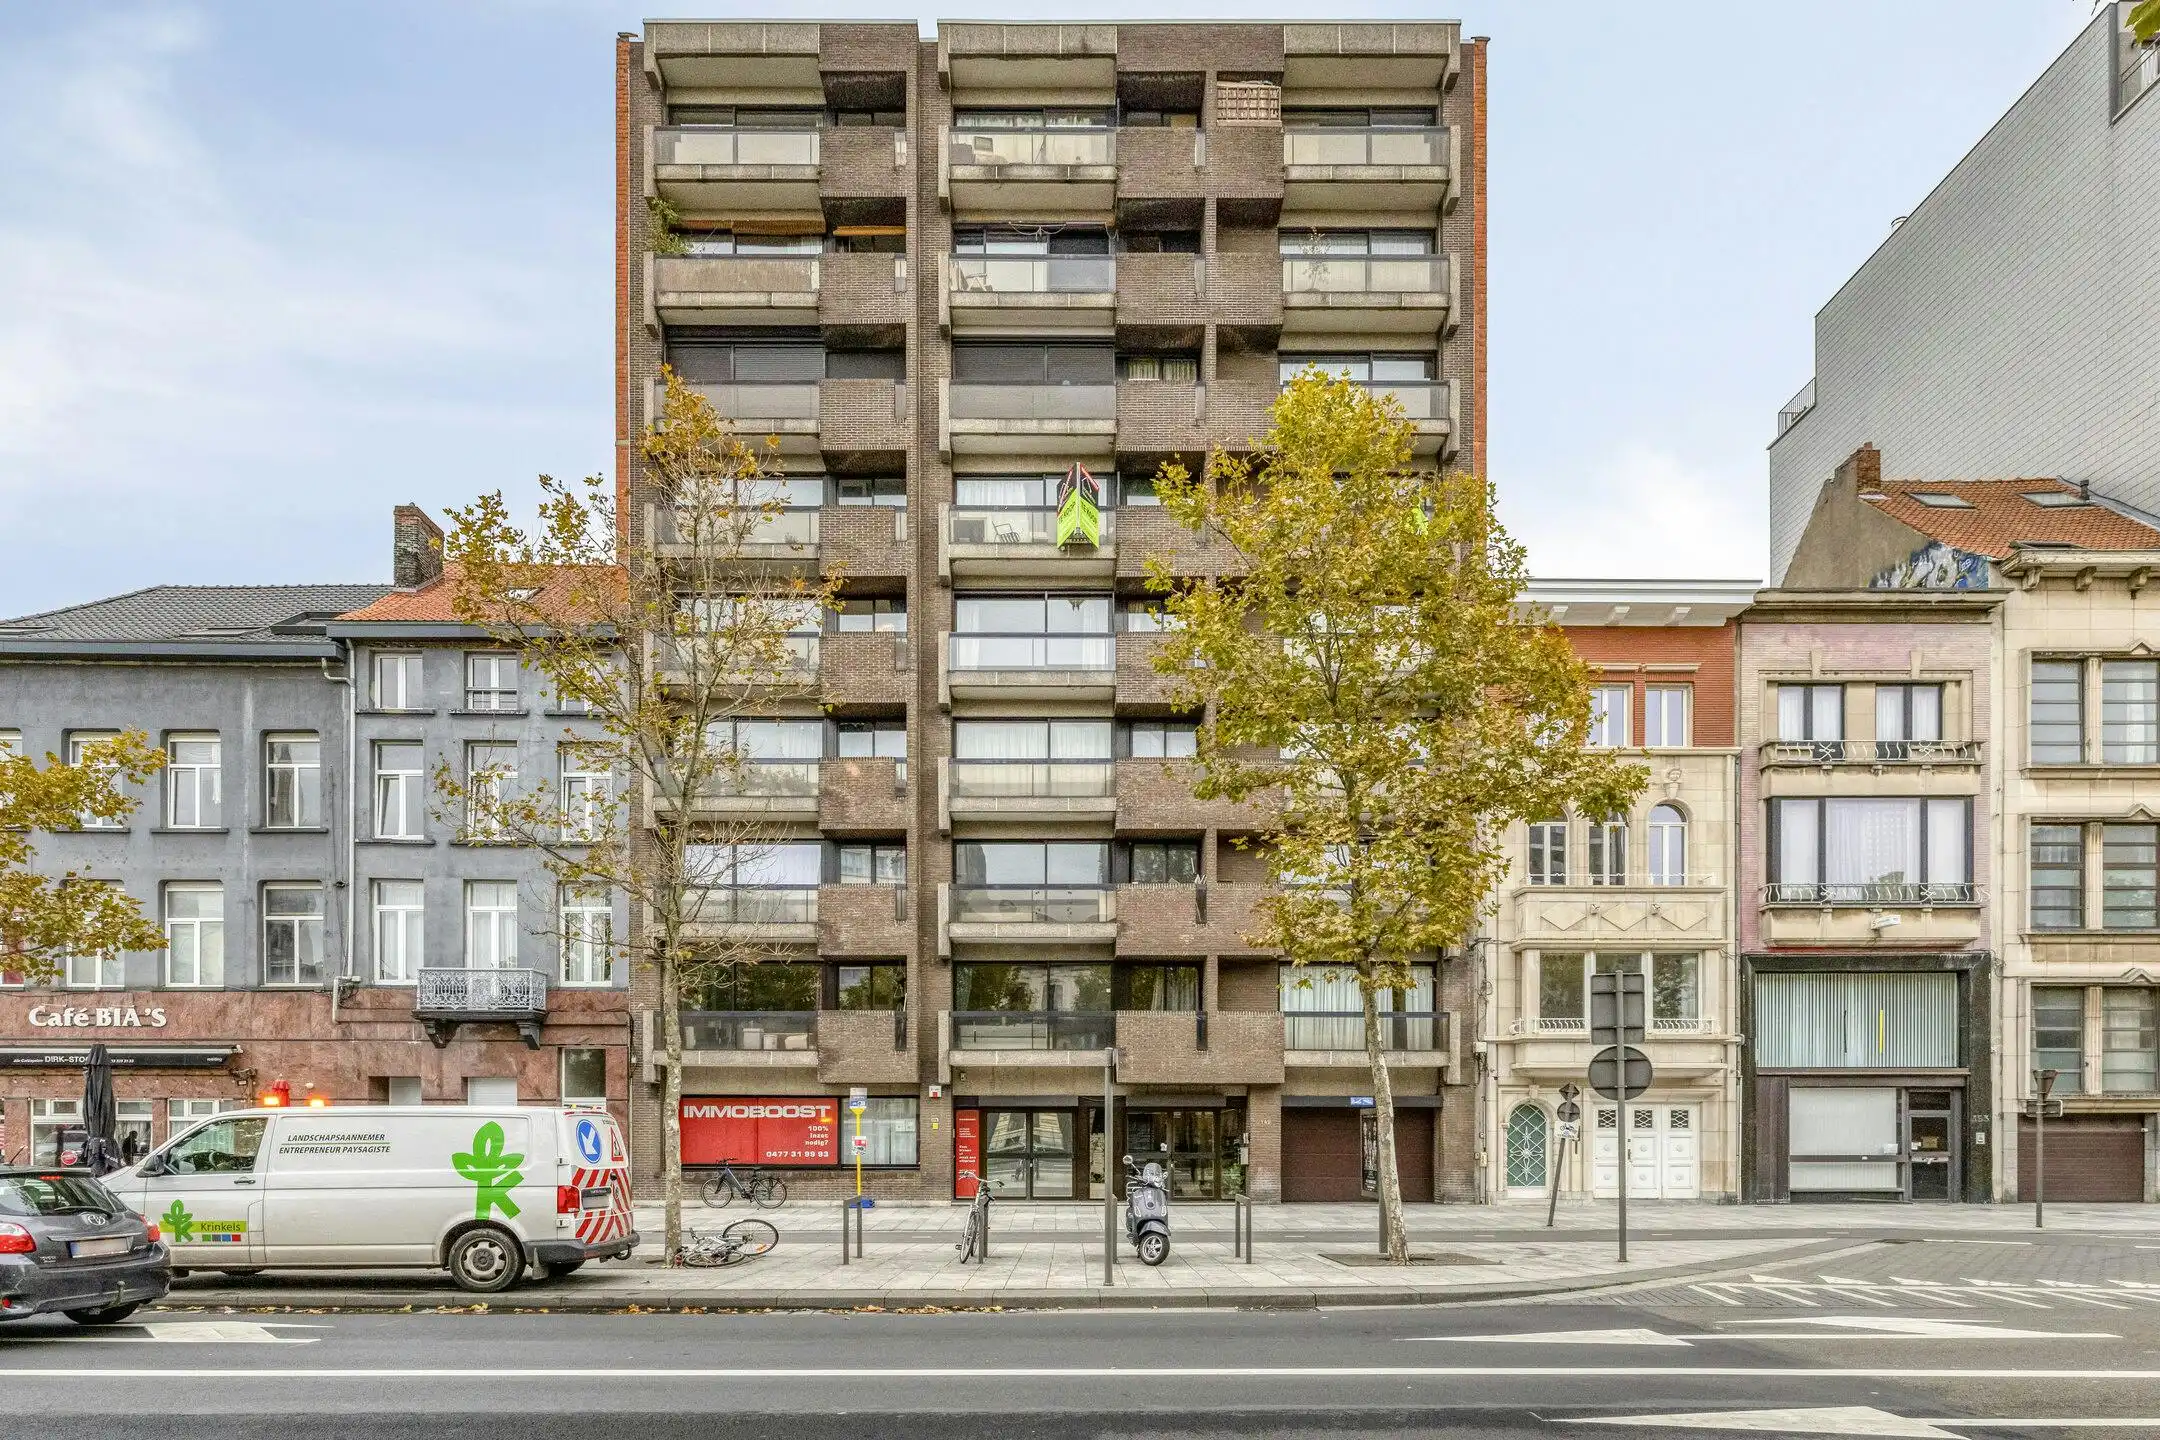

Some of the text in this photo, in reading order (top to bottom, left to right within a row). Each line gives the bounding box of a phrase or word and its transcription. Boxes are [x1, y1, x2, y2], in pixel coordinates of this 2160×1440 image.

[28, 1006, 167, 1027] Café BIA'S
[683, 1105, 831, 1118] IMMOBOOST
[287, 1133, 385, 1142] LANDSCHAPSAANNEMER
[804, 1139, 829, 1147] nodig?
[279, 1145, 391, 1154] ENTREPRENEUR PAYSAGISTE
[200, 1221, 241, 1232] Krinkels
